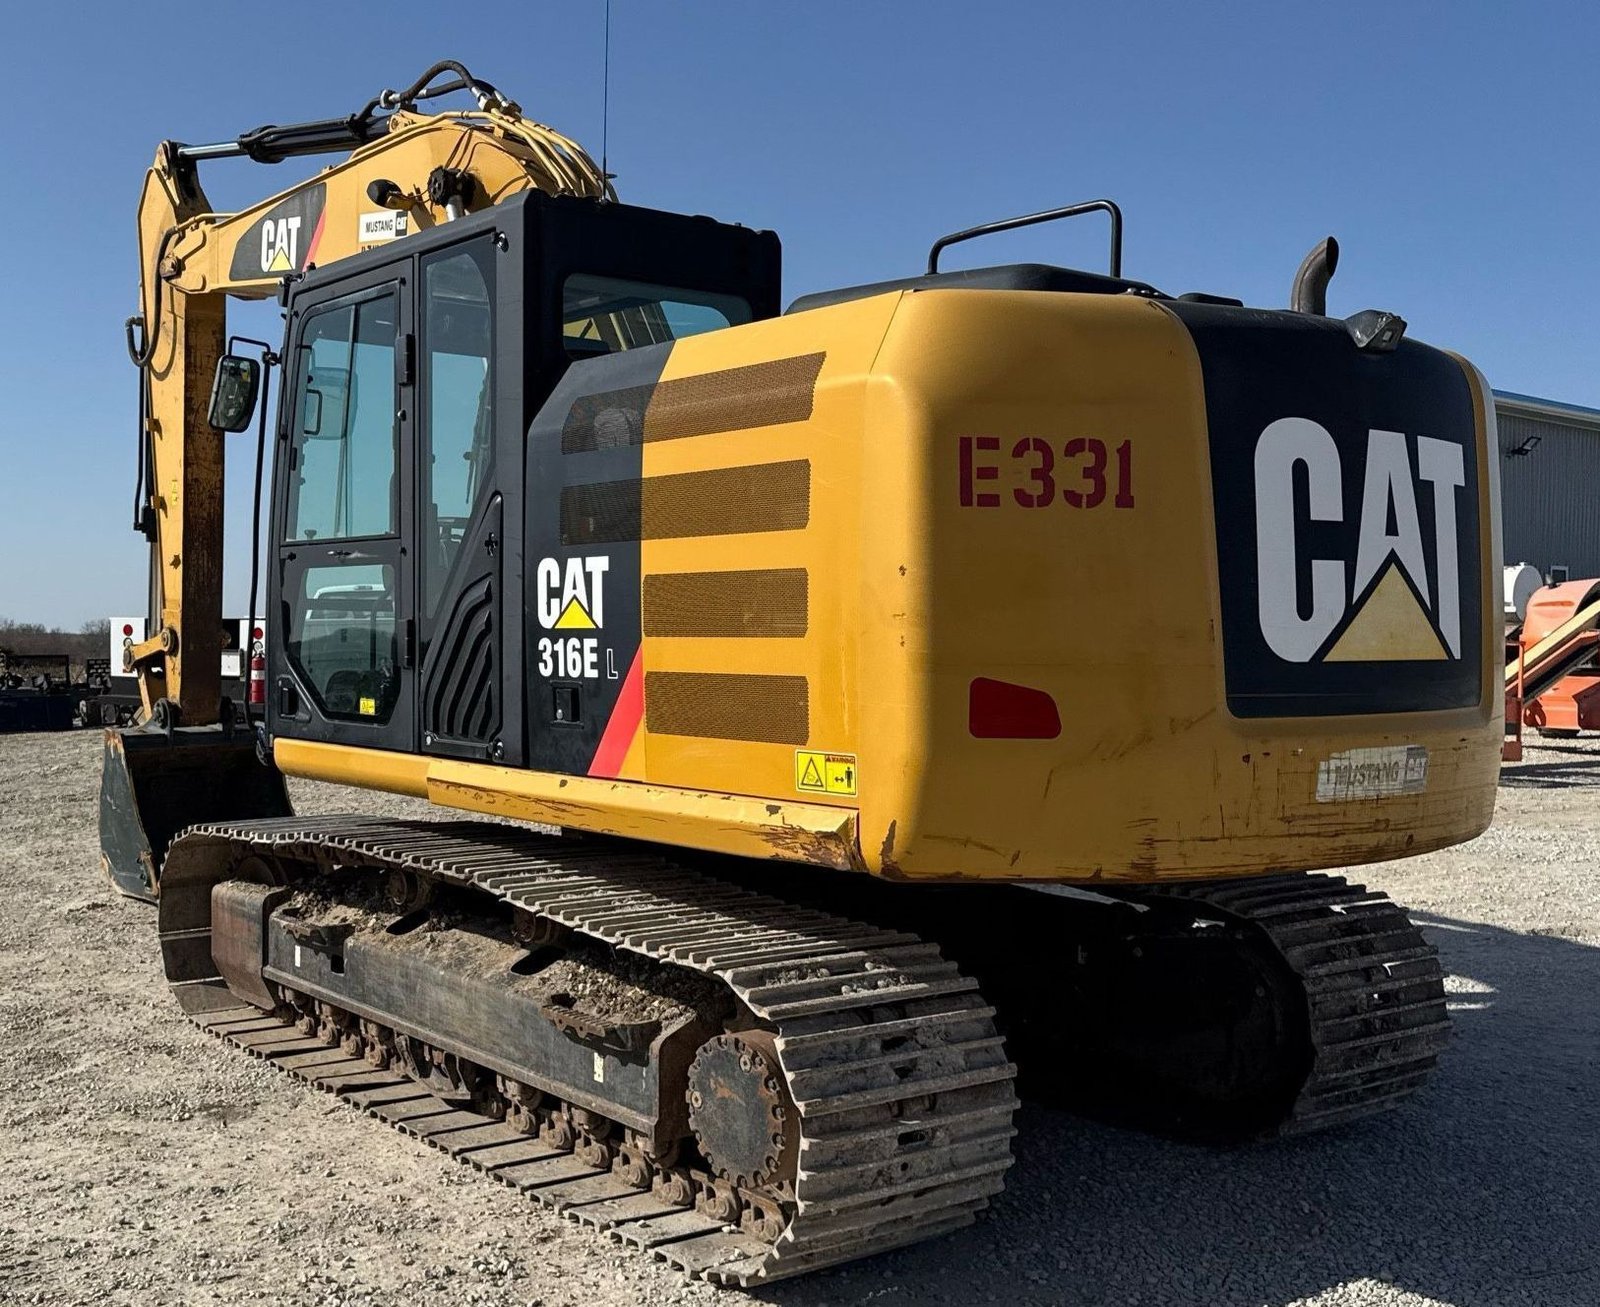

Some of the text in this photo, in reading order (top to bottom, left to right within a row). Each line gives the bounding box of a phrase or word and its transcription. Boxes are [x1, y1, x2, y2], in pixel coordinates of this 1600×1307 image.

[261, 217, 301, 272] CAT
[365, 220, 393, 233] MUSTANG
[959, 437, 1135, 509] E331
[1254, 417, 1465, 663] CAT
[537, 556, 609, 629] CAT
[538, 637, 618, 679] 316E L
